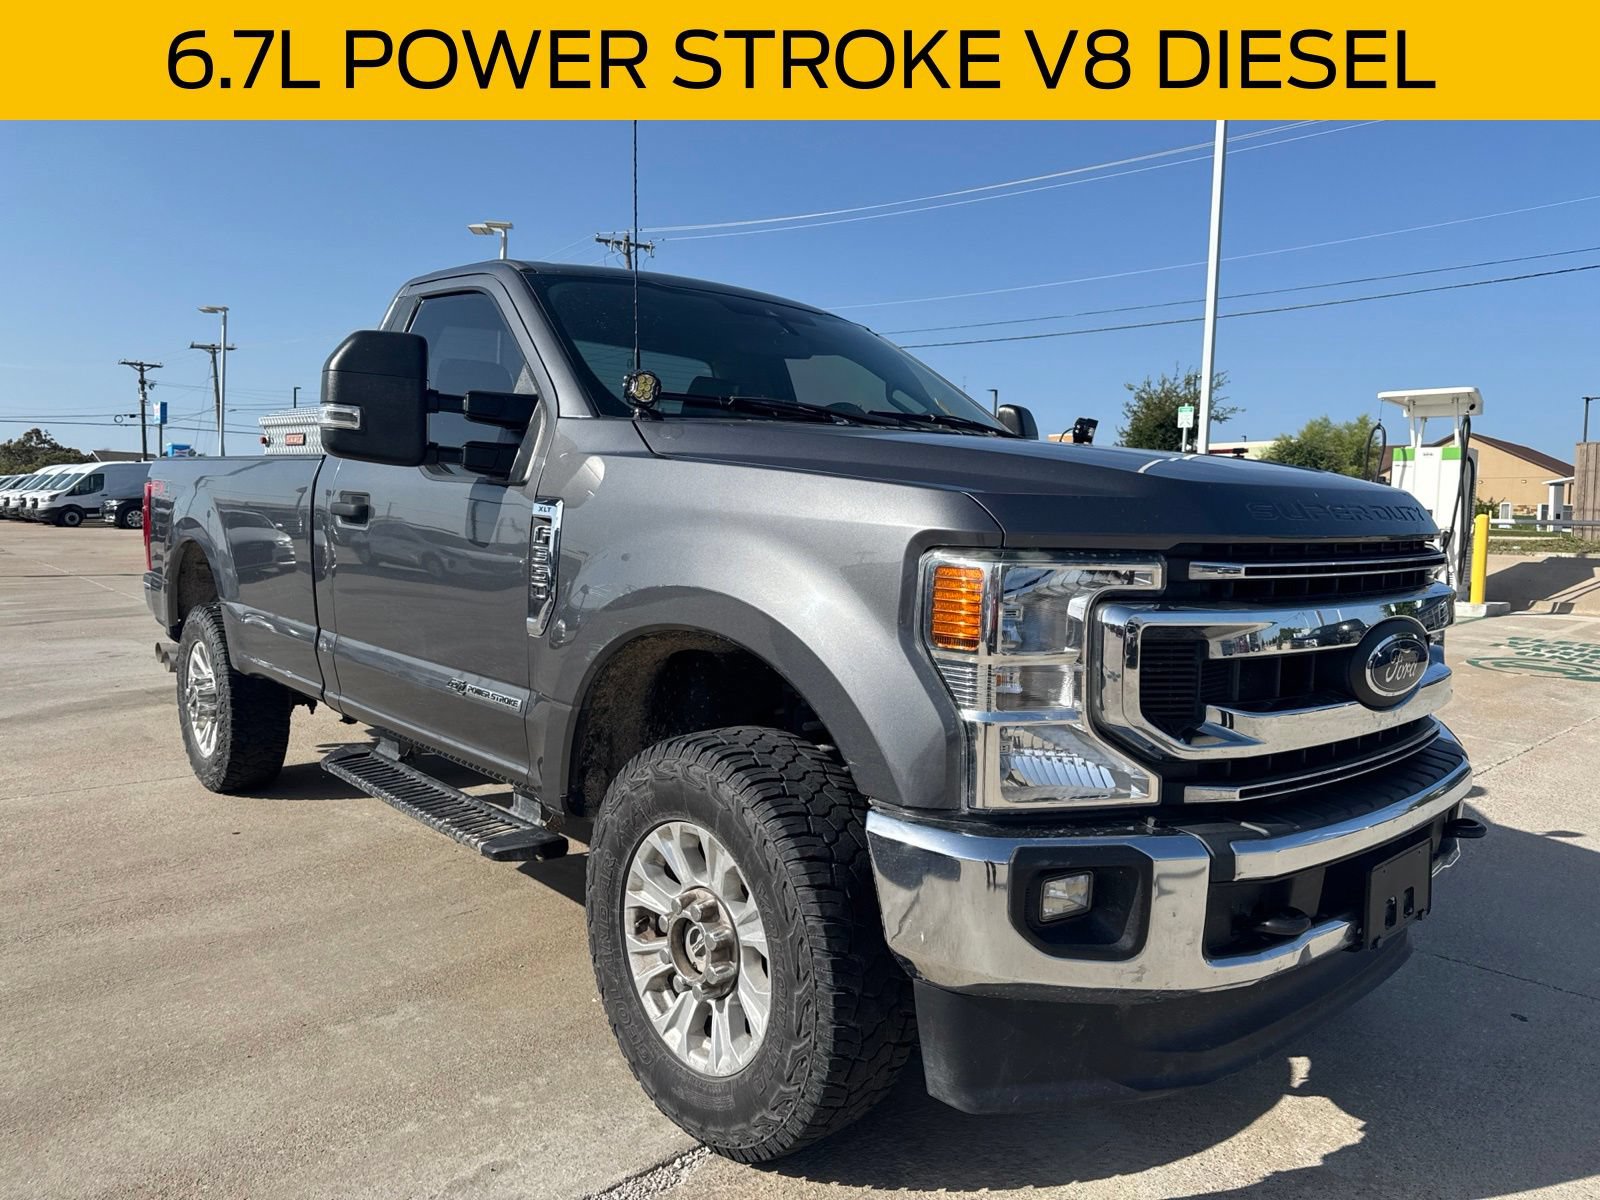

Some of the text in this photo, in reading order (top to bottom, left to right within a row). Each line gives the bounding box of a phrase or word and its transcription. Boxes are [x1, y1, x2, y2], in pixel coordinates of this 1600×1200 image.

[1246, 499, 1425, 522] SUPER DUTY
[1385, 648, 1418, 683] Ford
[467, 685, 490, 699] POWER
[490, 693, 519, 708] STROKE
